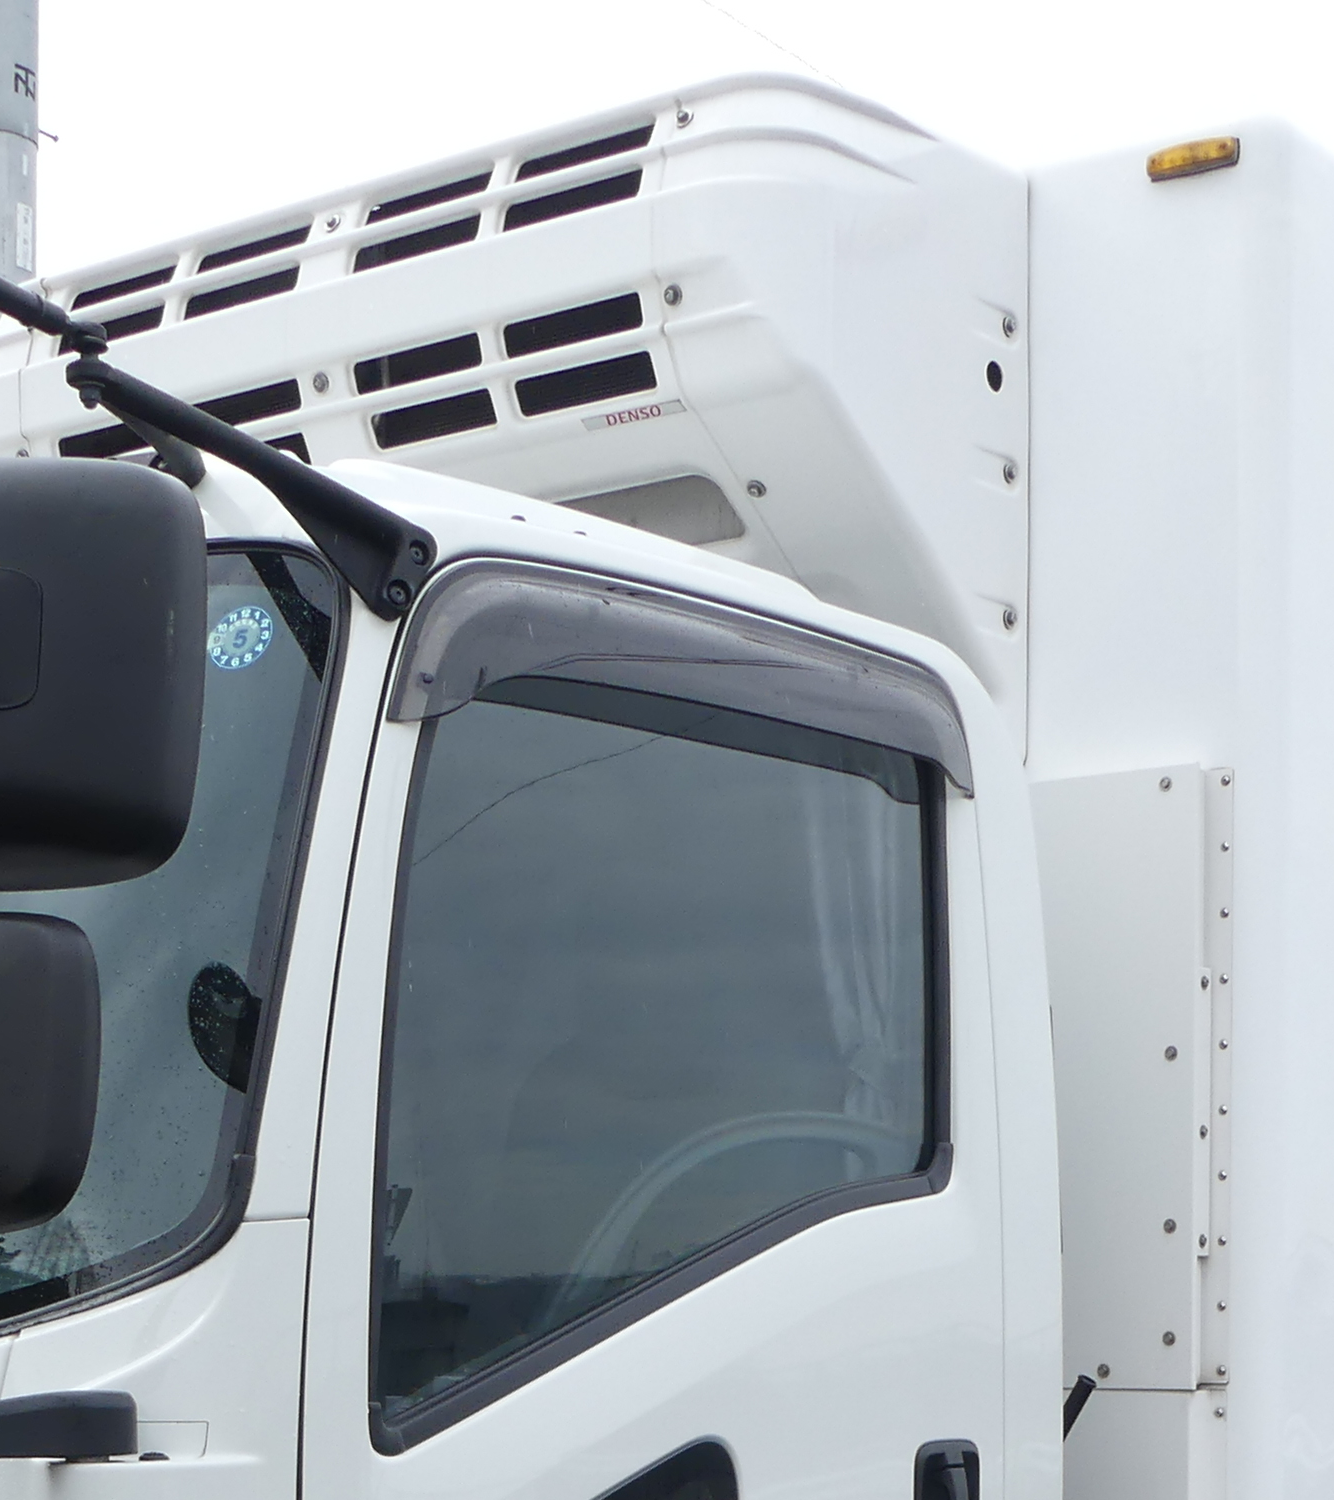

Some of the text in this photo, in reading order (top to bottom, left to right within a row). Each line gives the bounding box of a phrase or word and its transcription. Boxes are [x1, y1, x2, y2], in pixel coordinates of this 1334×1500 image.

[606, 404, 661, 426] DENSO
[229, 613, 237, 622] 11
[241, 609, 251, 617] 12
[217, 623, 227, 632] 10
[261, 619, 269, 627] 2
[232, 629, 248, 648] 5
[261, 631, 269, 640] 3
[255, 643, 263, 651] 4
[220, 656, 228, 664] 7
[231, 657, 239, 667] 6
[244, 653, 252, 662] 5
